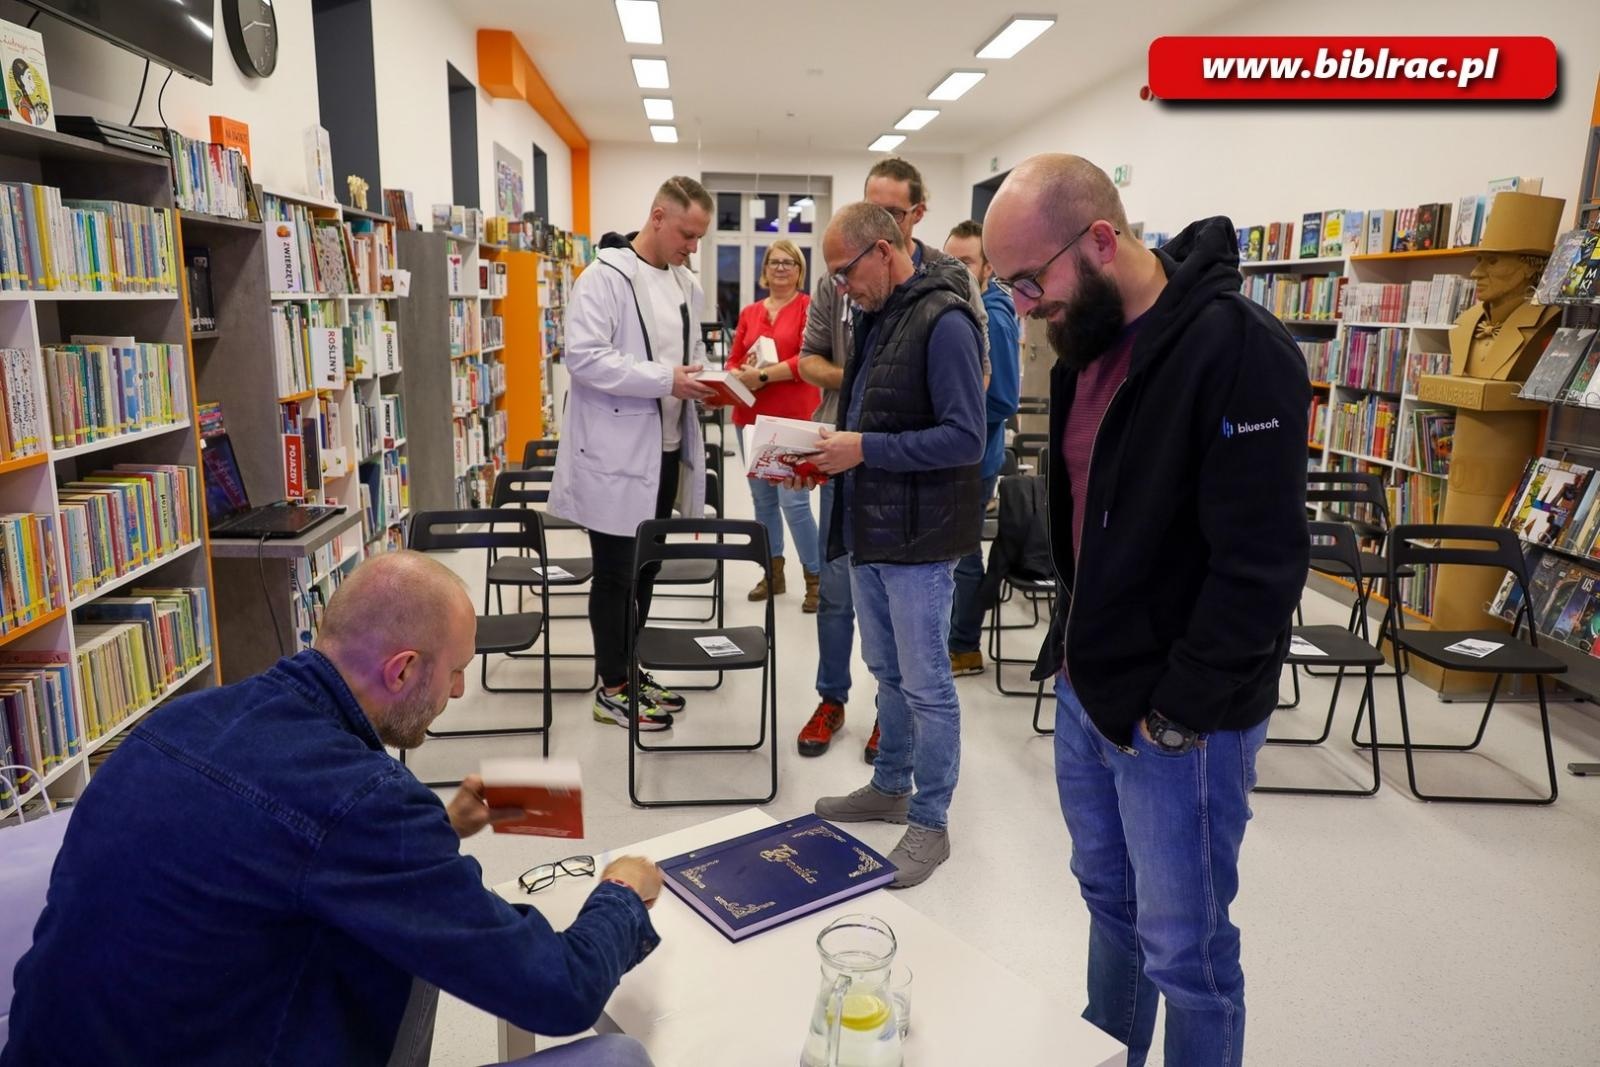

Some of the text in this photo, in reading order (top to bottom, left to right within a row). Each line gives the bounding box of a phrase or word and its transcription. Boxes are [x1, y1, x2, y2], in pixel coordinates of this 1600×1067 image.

[283, 242, 294, 290] ZWIERZĘTA
[327, 330, 337, 374] ROŚLINY
[1238, 418, 1280, 434] bluesoft
[288, 444, 297, 485] POJAZDY
